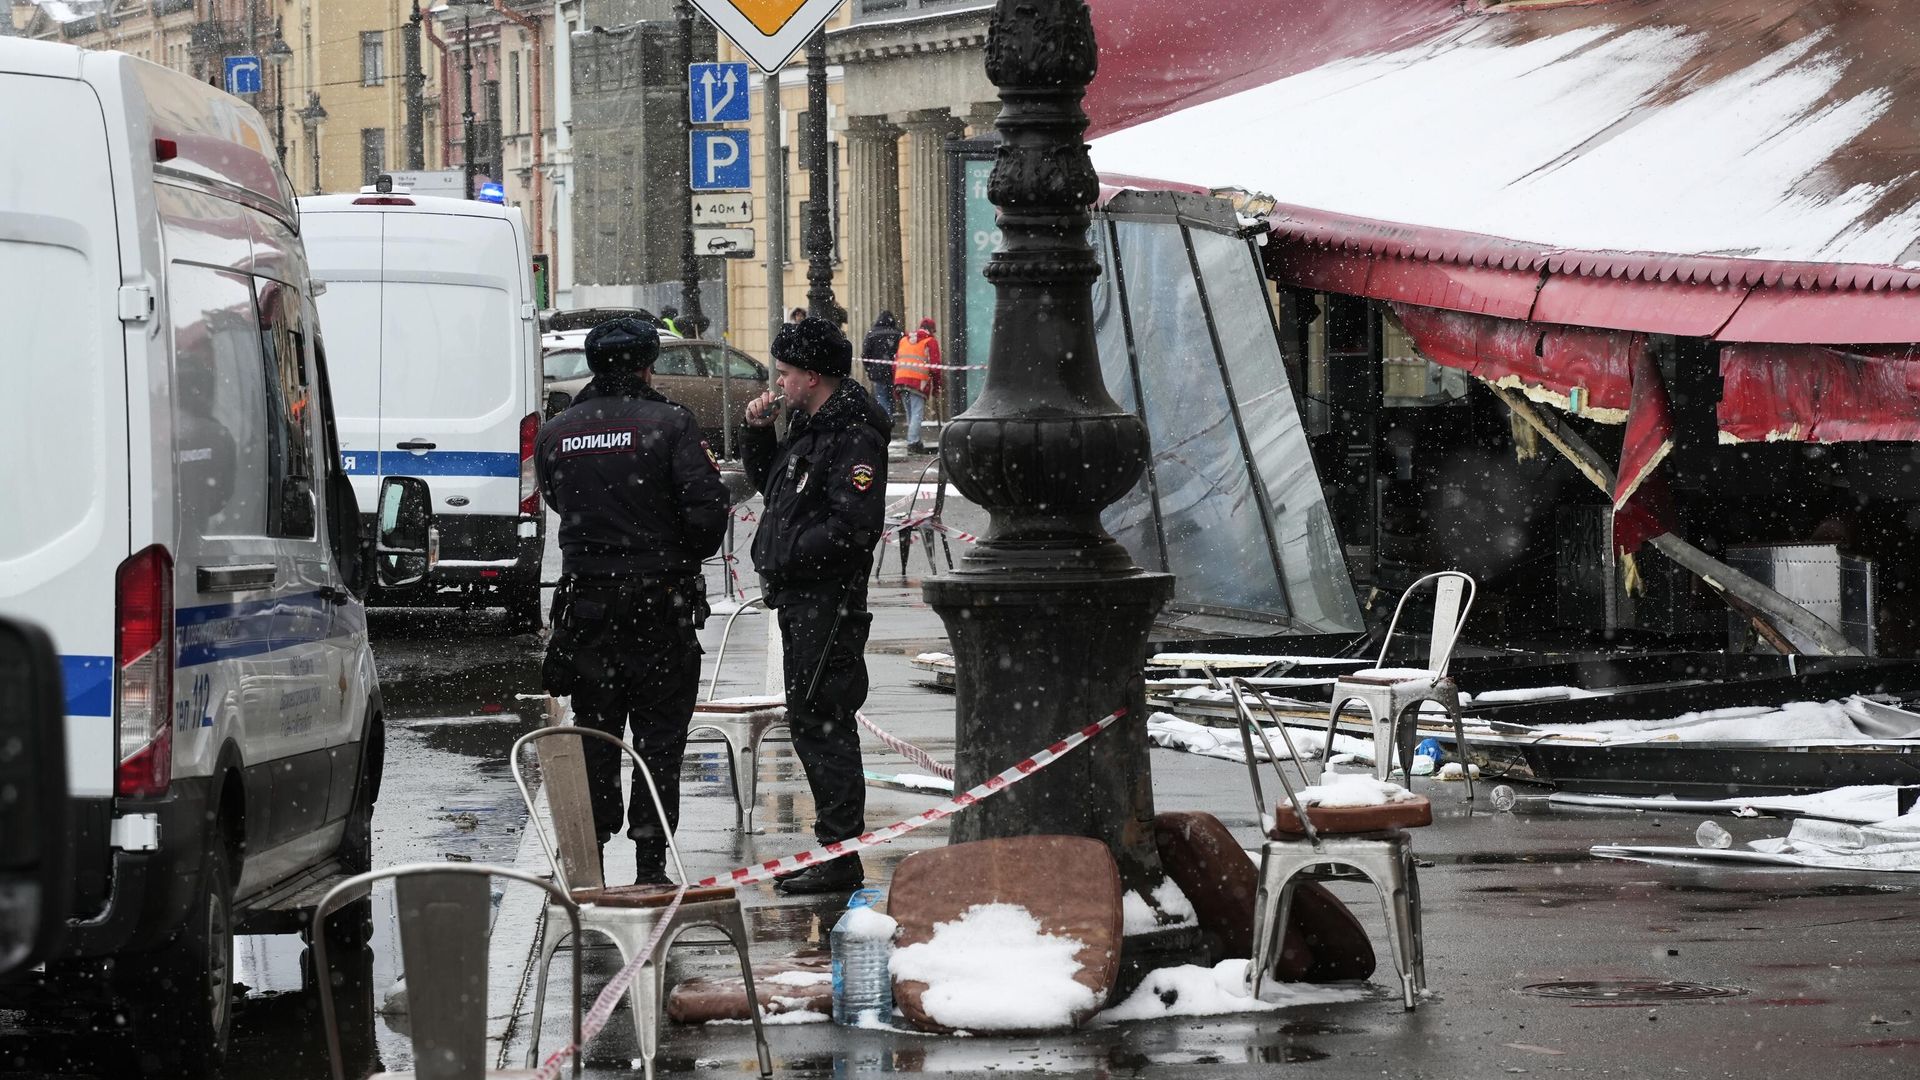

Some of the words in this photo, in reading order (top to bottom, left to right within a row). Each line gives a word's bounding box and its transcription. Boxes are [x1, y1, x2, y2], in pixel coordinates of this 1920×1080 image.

[706, 135, 739, 183] P
[562, 432, 631, 452] ПОЛИЦИЯ
[342, 455, 356, 470] Я
[192, 673, 213, 729] 112
